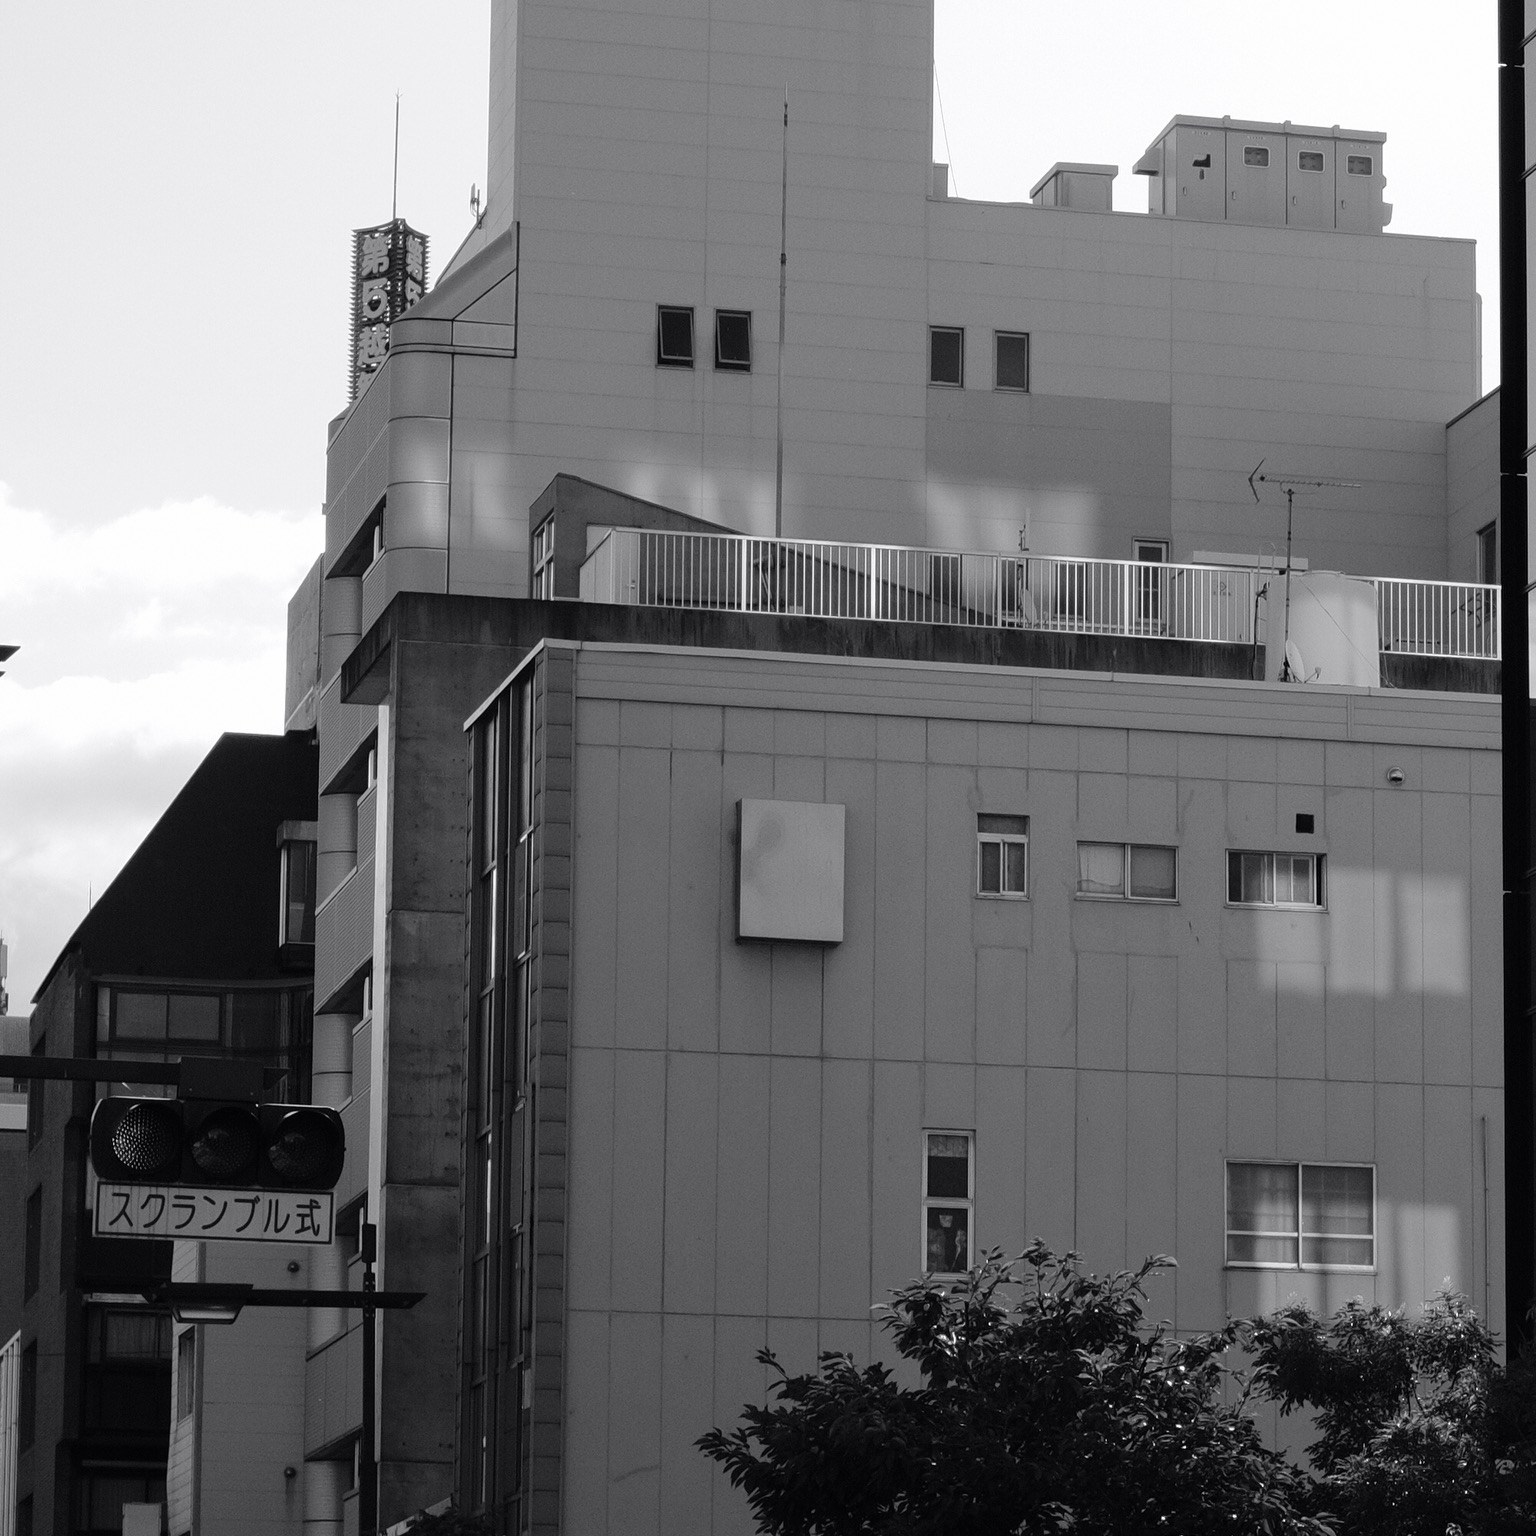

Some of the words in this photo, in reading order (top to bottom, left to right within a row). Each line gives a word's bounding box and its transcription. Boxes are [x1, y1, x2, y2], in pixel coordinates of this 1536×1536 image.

[108, 1191, 322, 1237] スクランブル式
